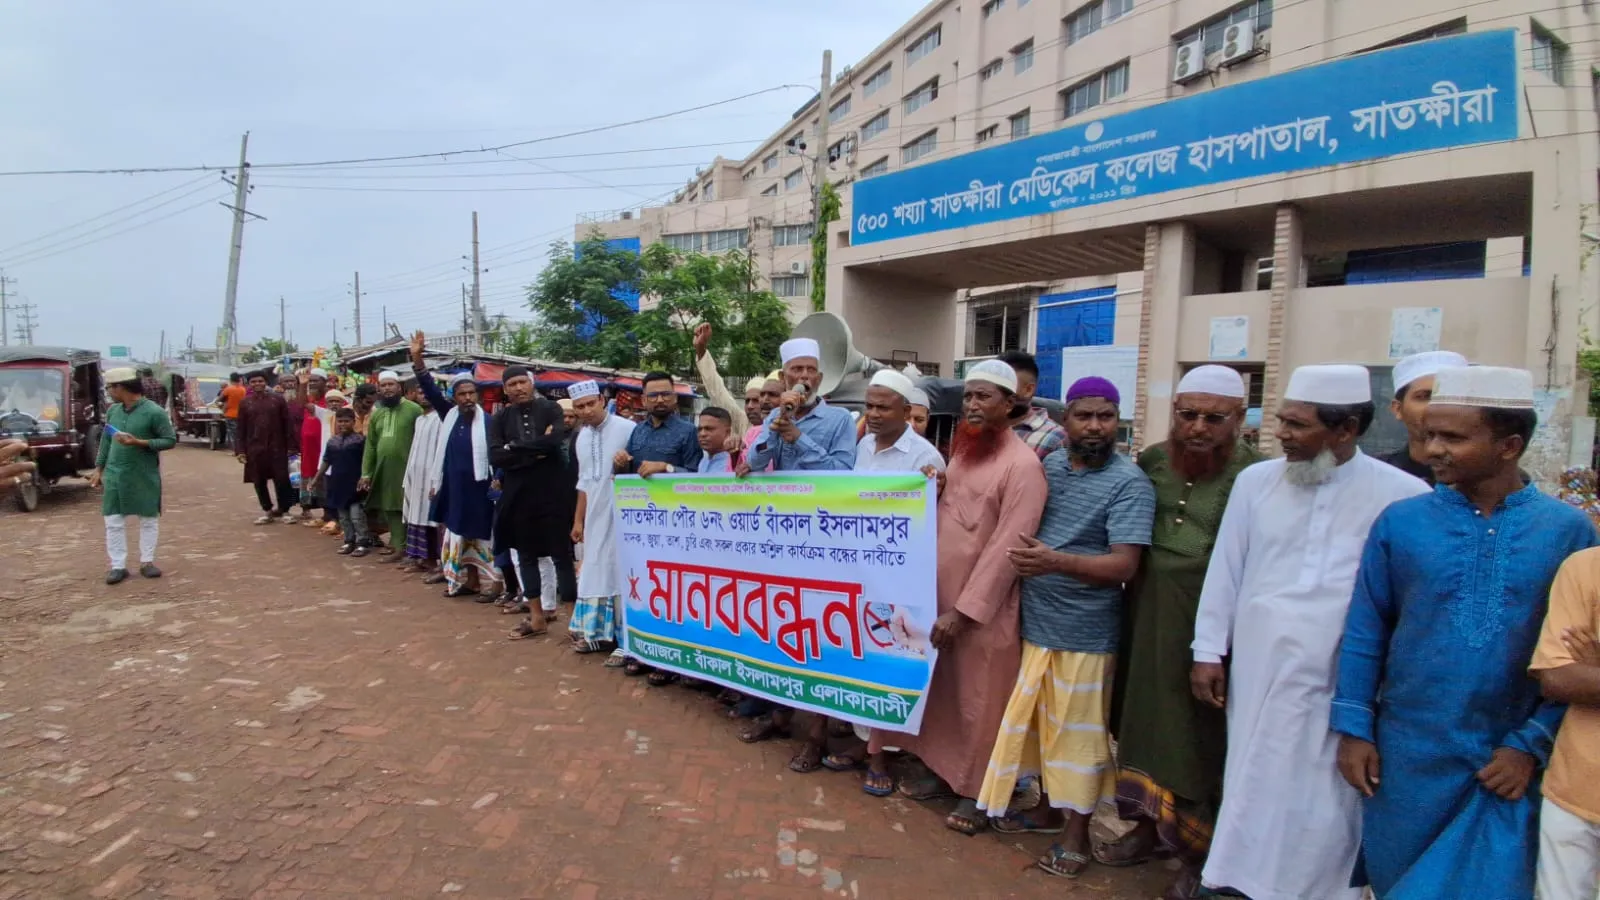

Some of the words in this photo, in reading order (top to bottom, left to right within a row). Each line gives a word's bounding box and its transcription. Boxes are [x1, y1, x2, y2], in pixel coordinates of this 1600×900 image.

[857, 212, 888, 233] ৫০০
[892, 198, 927, 226] শয্যা
[930, 179, 1004, 220] সাতক্ষীরা
[1009, 162, 1099, 204] মেডিকেল
[1104, 145, 1181, 184] কলেজ
[1187, 115, 1339, 172] হাসপাতাল,
[1350, 81, 1498, 139] সাতক্ষীরা
[621, 503, 668, 528] সাতক্ষীরা
[672, 504, 696, 529] পৌর
[701, 510, 724, 532] ৬নং
[729, 505, 761, 533] ওয়ার্ড
[765, 505, 812, 537] বাঁকাল
[817, 507, 911, 546] ইসলামপুর
[735, 541, 757, 556] প্রকার
[787, 540, 825, 560] কার্যক্রম
[829, 547, 858, 564] বন্ধের
[862, 544, 907, 567] দাবীতে
[646, 559, 864, 665] মানববন্ধন
[633, 636, 682, 663] আয়োজনে
[693, 649, 732, 676] বাঁকাল
[735, 659, 805, 699] ইসলামপুর
[811, 684, 912, 719] এলাকাবাসী
